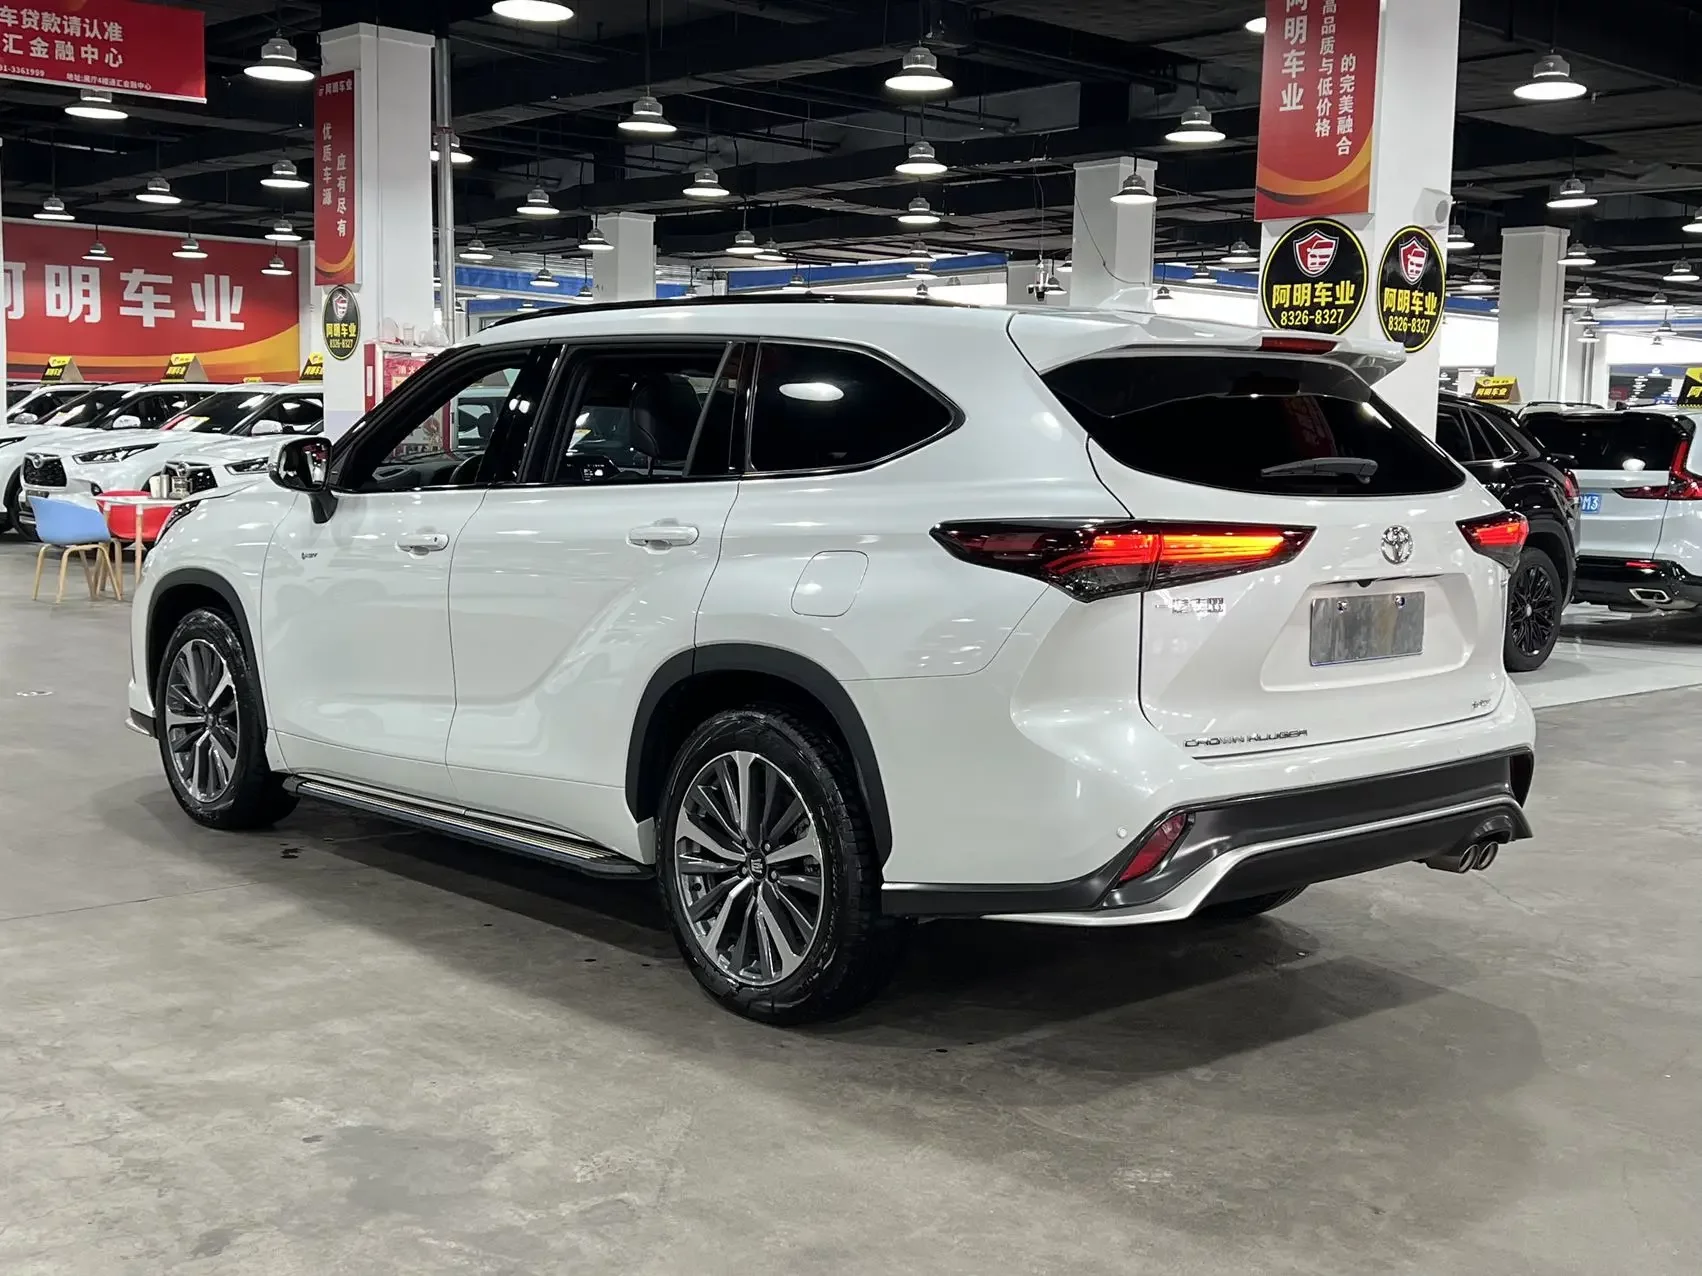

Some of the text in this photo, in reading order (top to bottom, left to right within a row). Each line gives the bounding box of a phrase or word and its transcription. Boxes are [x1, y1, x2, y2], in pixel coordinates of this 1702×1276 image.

[0, 5, 124, 43] 车贷款请认准
[2, 33, 123, 68] 汇金融中心
[1315, 0, 1337, 138] 高品质与低价格
[1336, 53, 1357, 156] 的完美融合
[336, 153, 348, 237] 应有尽有
[1271, 280, 1356, 309] 阿明车业
[1383, 287, 1438, 316] 阿明车业
[325, 322, 357, 338] 阿明车业
[1280, 308, 1345, 326] 8326-8327
[1388, 315, 1431, 334] 8326-8327
